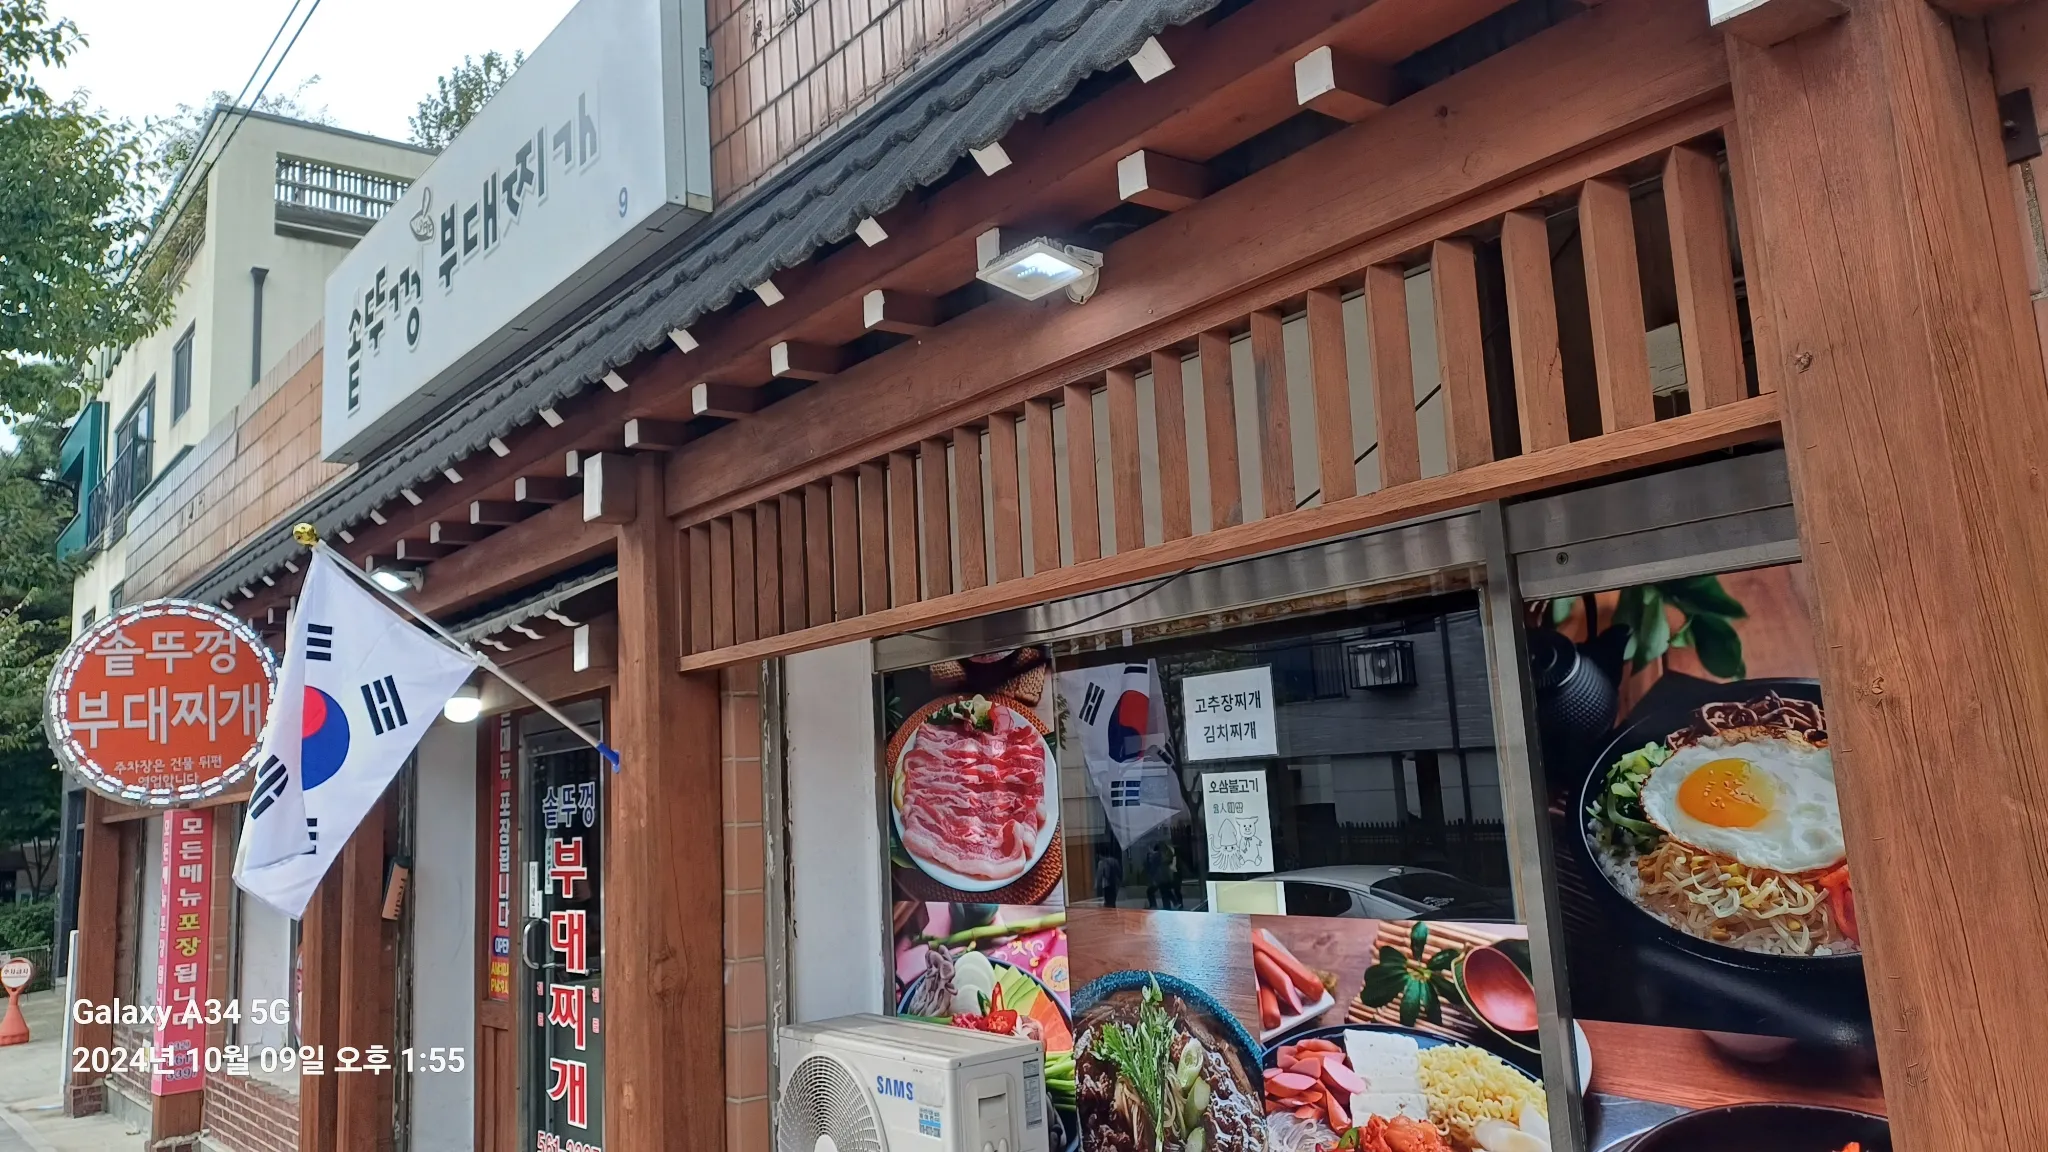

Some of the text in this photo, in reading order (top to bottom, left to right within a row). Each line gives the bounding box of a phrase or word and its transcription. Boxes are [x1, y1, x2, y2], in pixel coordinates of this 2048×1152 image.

[95, 630, 237, 677] 솥뚜껑
[69, 683, 261, 748] 부대찌개
[1194, 690, 1261, 714] 고추장찌개
[1203, 721, 1257, 744] 김치찌개
[114, 759, 165, 775] 주차장은
[170, 757, 194, 772] 건물
[1208, 777, 1259, 794] 오삼불고기
[542, 782, 595, 829] 솥뚜껑
[547, 836, 588, 1129] 부대찌개
